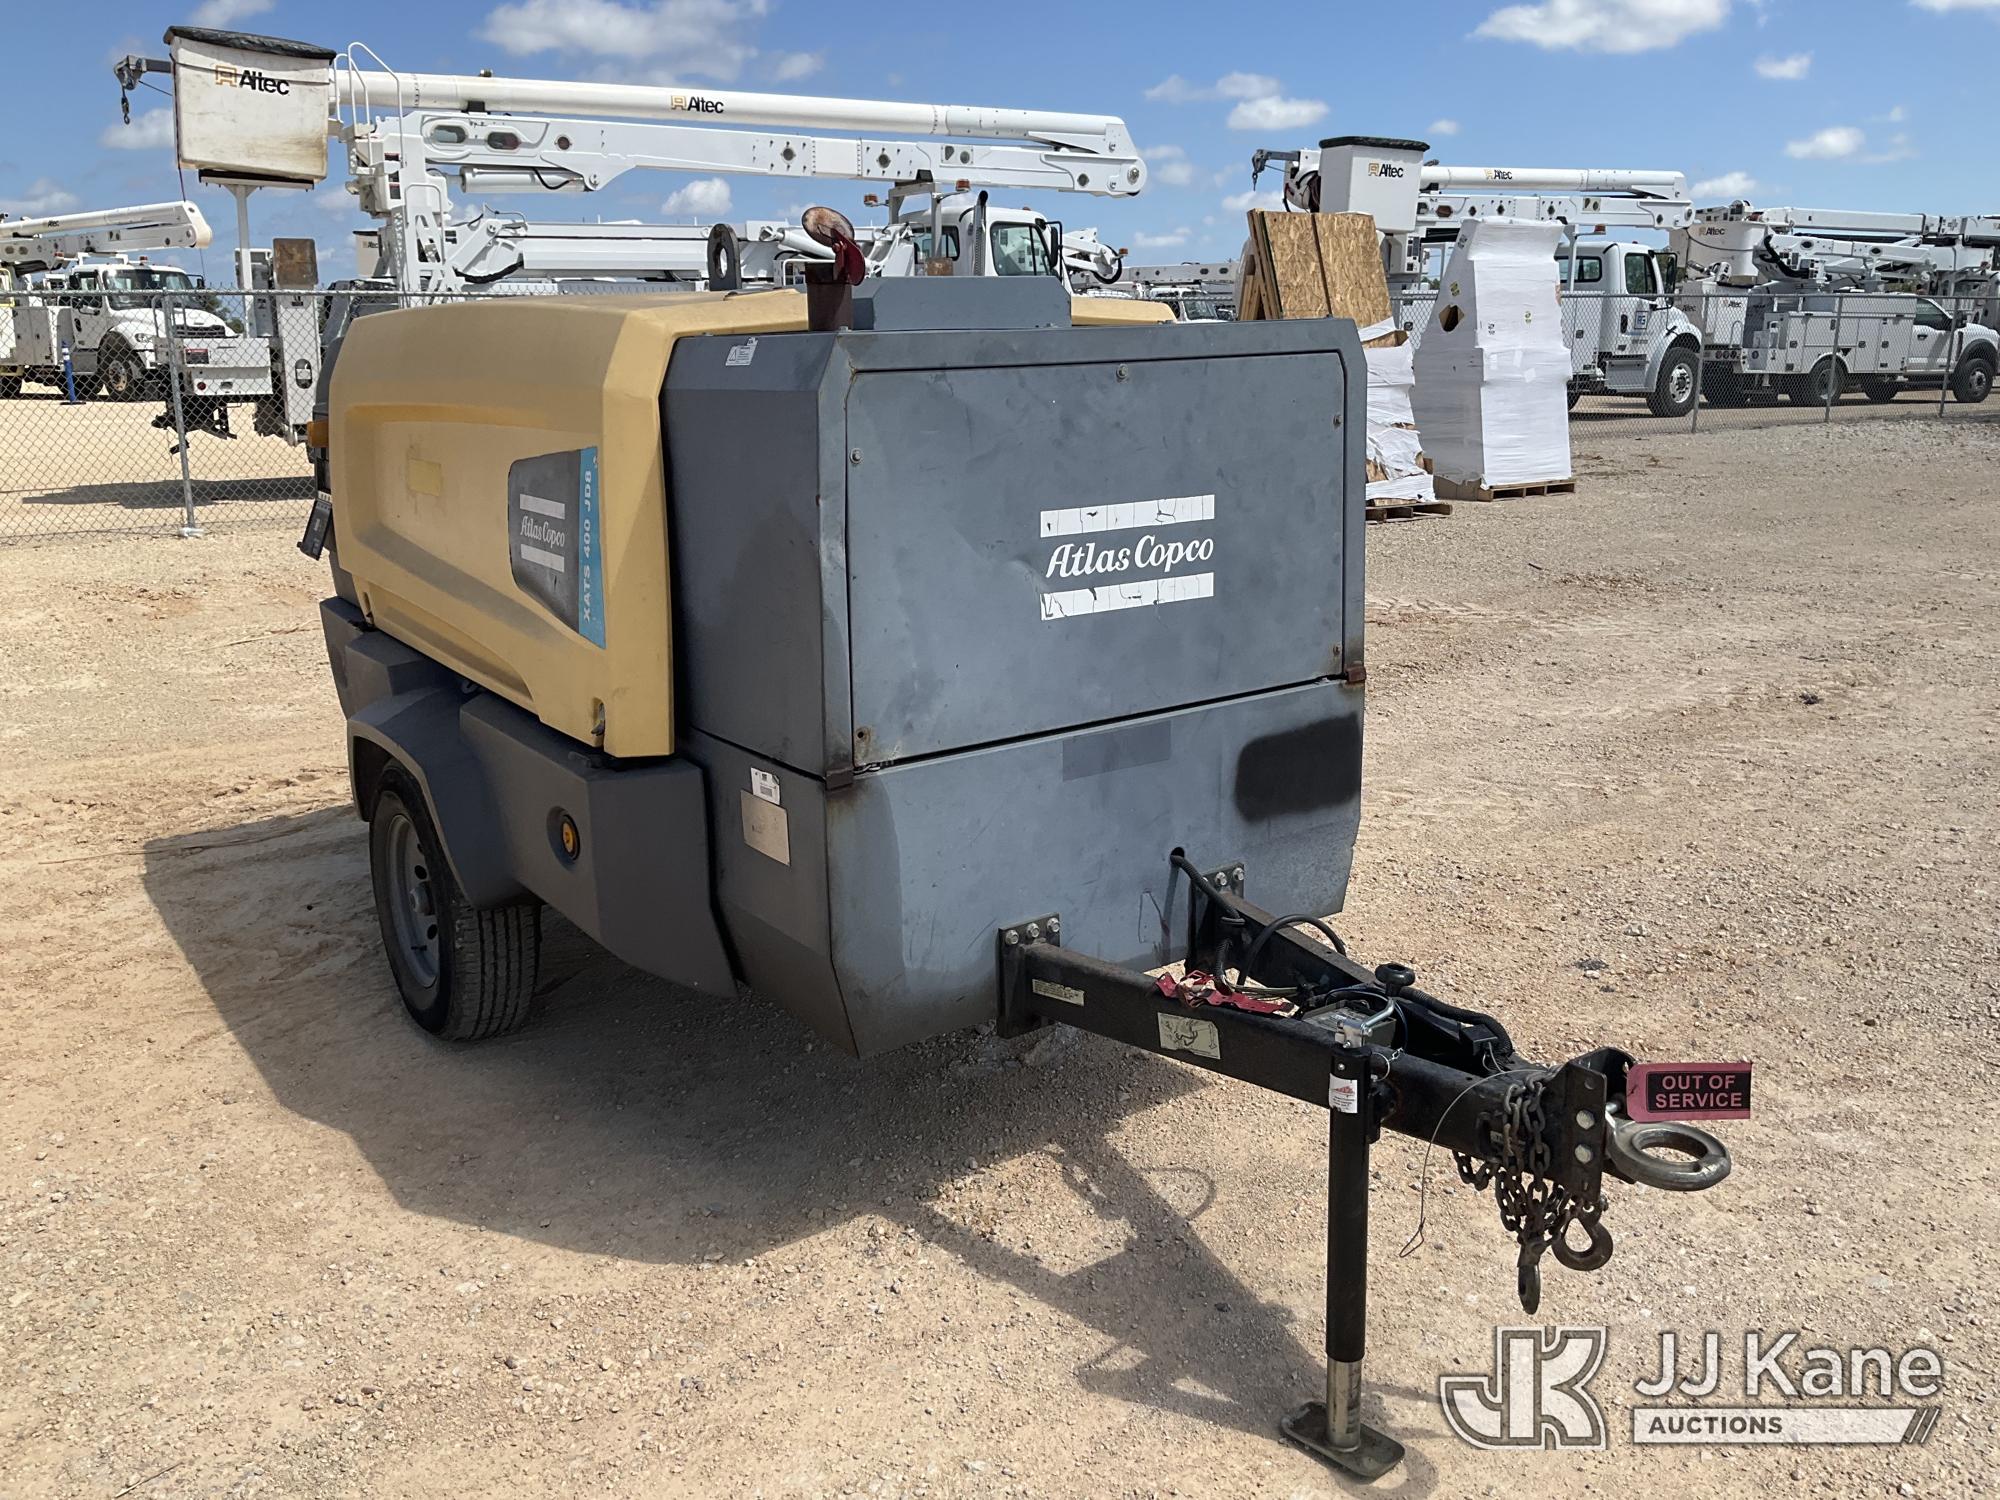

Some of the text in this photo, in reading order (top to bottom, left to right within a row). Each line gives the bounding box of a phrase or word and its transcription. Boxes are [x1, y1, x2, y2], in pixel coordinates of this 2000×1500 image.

[239, 69, 290, 96] Altec
[687, 96, 725, 114] Altec
[1379, 163, 1404, 178] Altec
[520, 515, 566, 549] Atlas Copco
[583, 470, 592, 622] XATS 400 JD8
[1045, 535, 1214, 578] Atlas Copco
[1662, 1074, 1736, 1090] OUT OF
[1655, 1092, 1742, 1108] SERVICE
